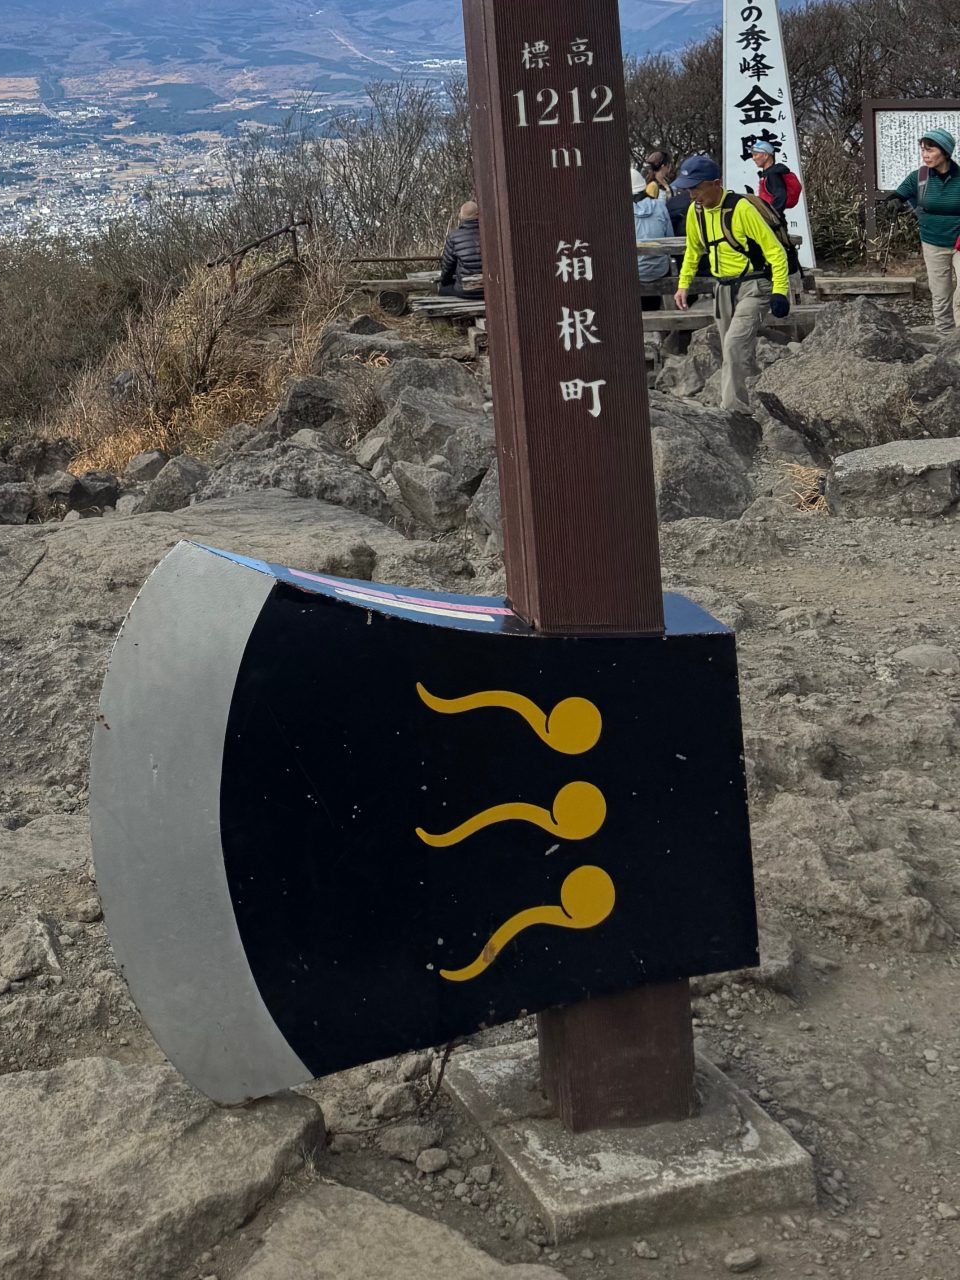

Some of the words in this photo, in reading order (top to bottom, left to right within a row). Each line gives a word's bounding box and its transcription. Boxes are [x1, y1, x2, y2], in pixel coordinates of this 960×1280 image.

[521, 37, 594, 70] 標高
[512, 84, 615, 127] 1212
[551, 146, 583, 169] m
[556, 239, 606, 418] 箱根町
